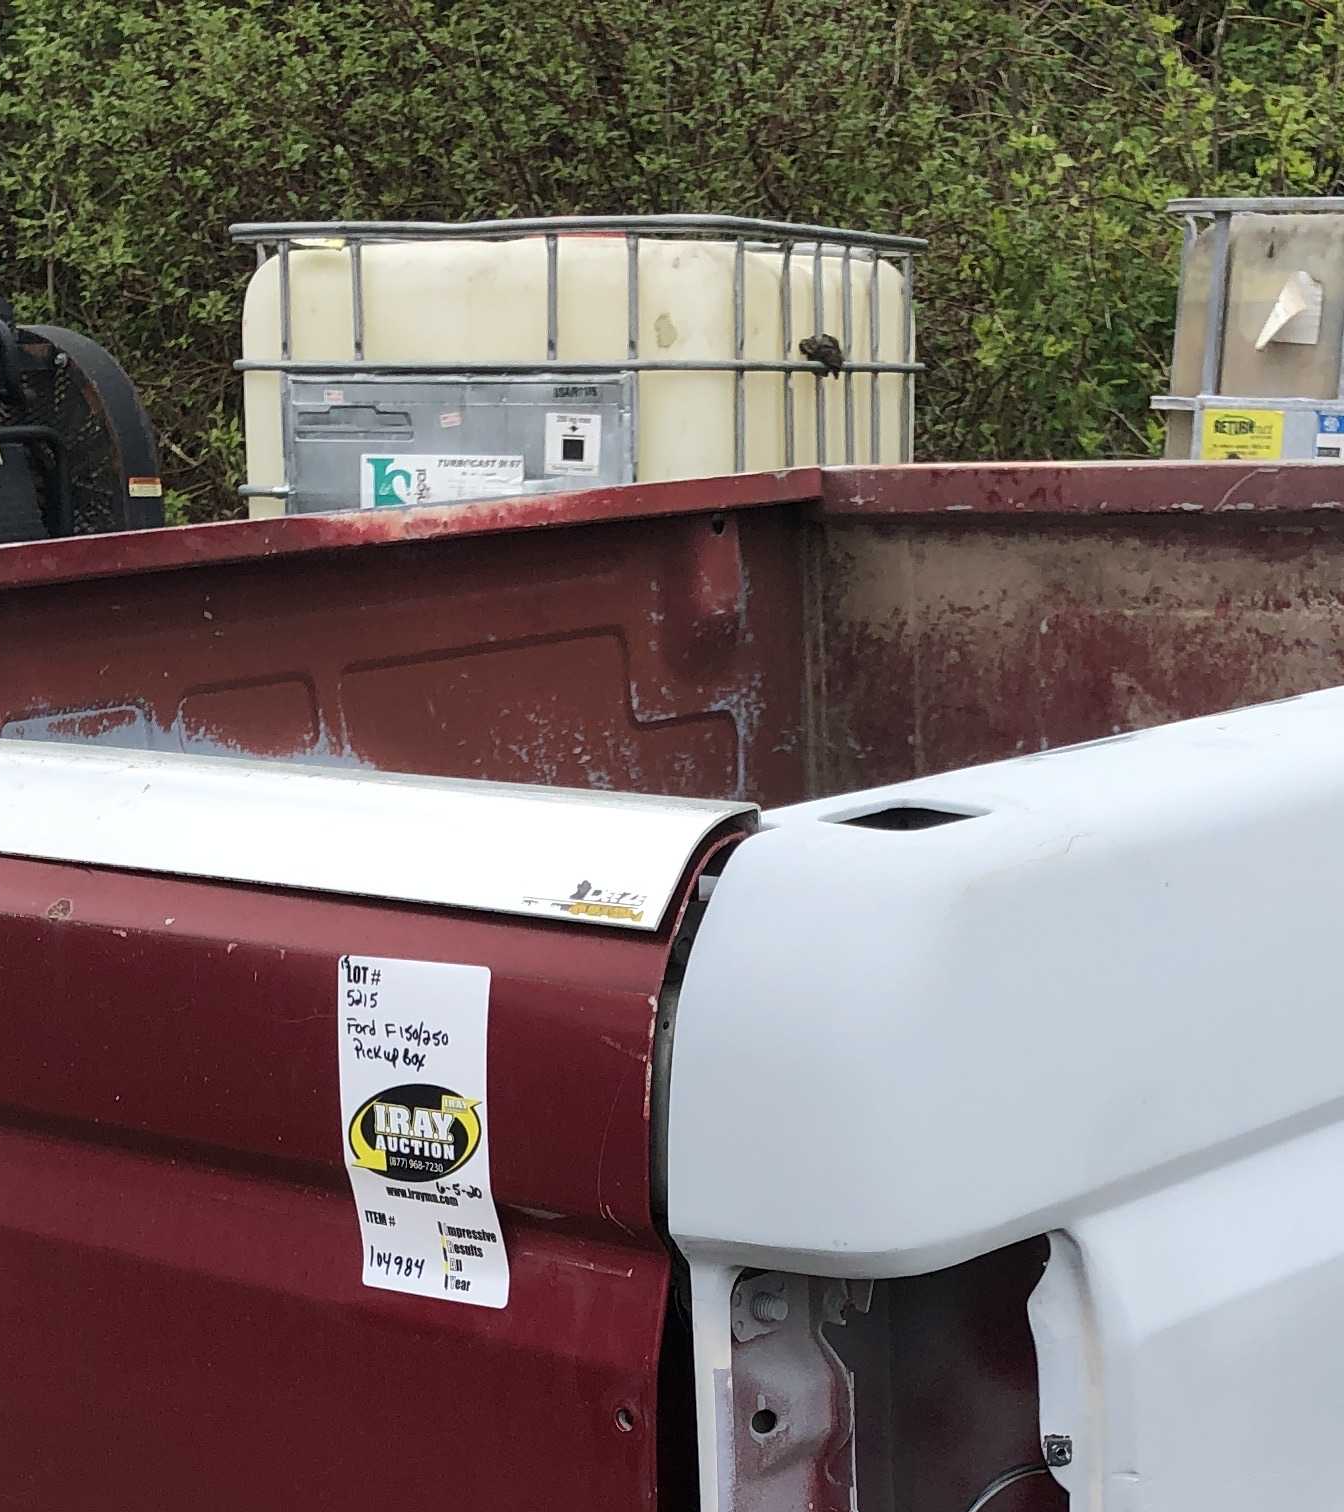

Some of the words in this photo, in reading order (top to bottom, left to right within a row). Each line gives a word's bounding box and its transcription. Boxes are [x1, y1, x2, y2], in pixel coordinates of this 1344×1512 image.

[347, 965, 369, 984] LOT
[371, 969, 381, 985] #
[346, 989, 378, 1008] 5215
[346, 1017, 376, 1036] Ford
[375, 1136, 455, 1161] AUCTION
[365, 1210, 387, 1226] ITEM
[444, 1222, 497, 1243] Impressive
[369, 1245, 425, 1279] 104984
